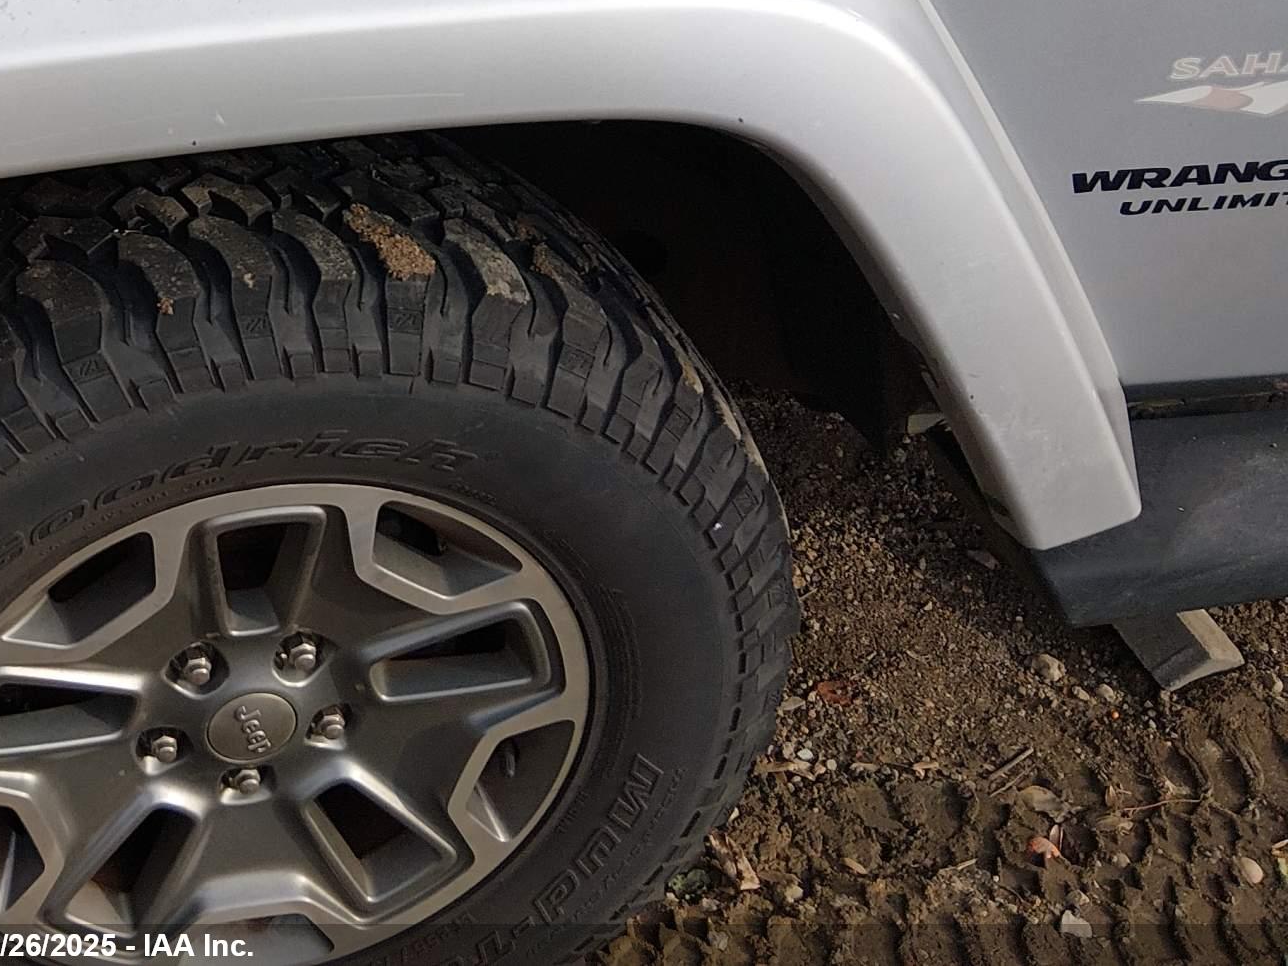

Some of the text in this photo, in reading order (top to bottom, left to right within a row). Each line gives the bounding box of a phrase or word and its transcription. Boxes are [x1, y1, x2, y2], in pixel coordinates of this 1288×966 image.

[1169, 52, 1288, 80] SAH
[1072, 159, 1288, 194] WRANG
[233, 705, 272, 753] Jeep
